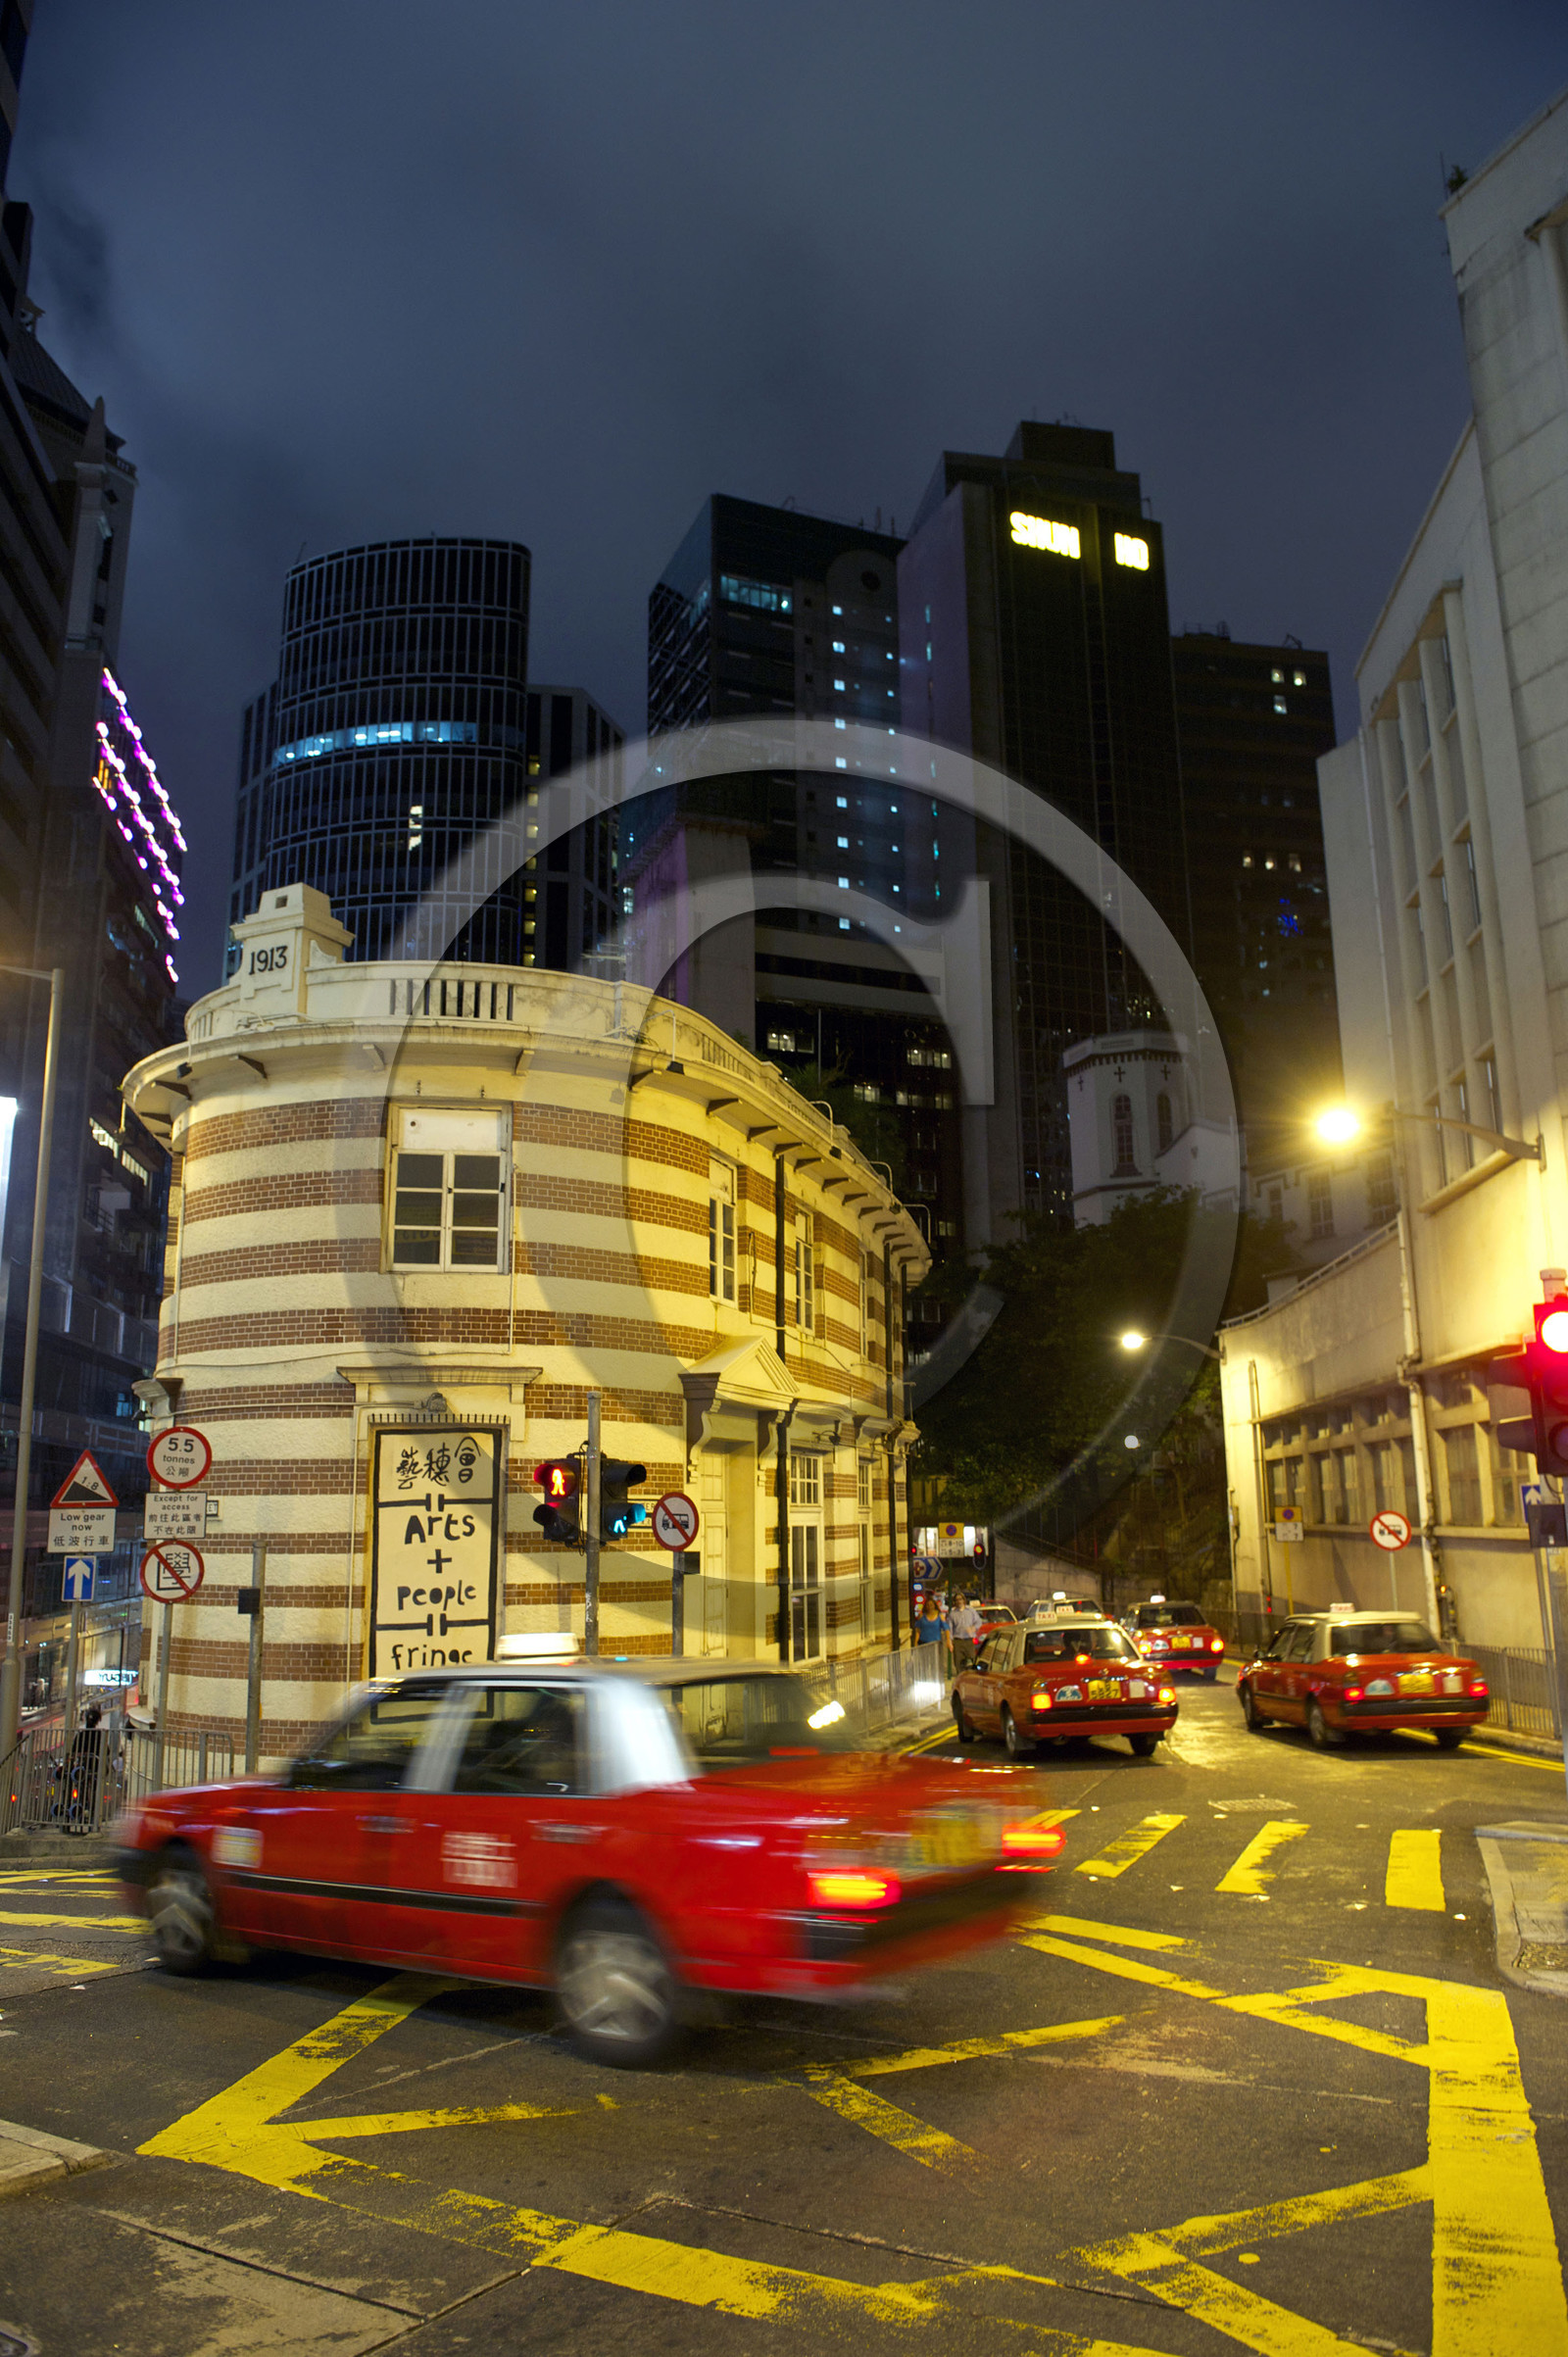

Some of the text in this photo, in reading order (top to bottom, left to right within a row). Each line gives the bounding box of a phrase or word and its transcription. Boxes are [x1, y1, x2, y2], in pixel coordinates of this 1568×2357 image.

[1009, 511, 1081, 560] SHUN
[248, 945, 289, 976] 1913
[168, 1437, 195, 1453] 5.5
[163, 1454, 196, 1464] tonnes
[83, 1513, 106, 1522] gear
[404, 1513, 476, 1546] Arts
[53, 1535, 110, 1547] 低波行車
